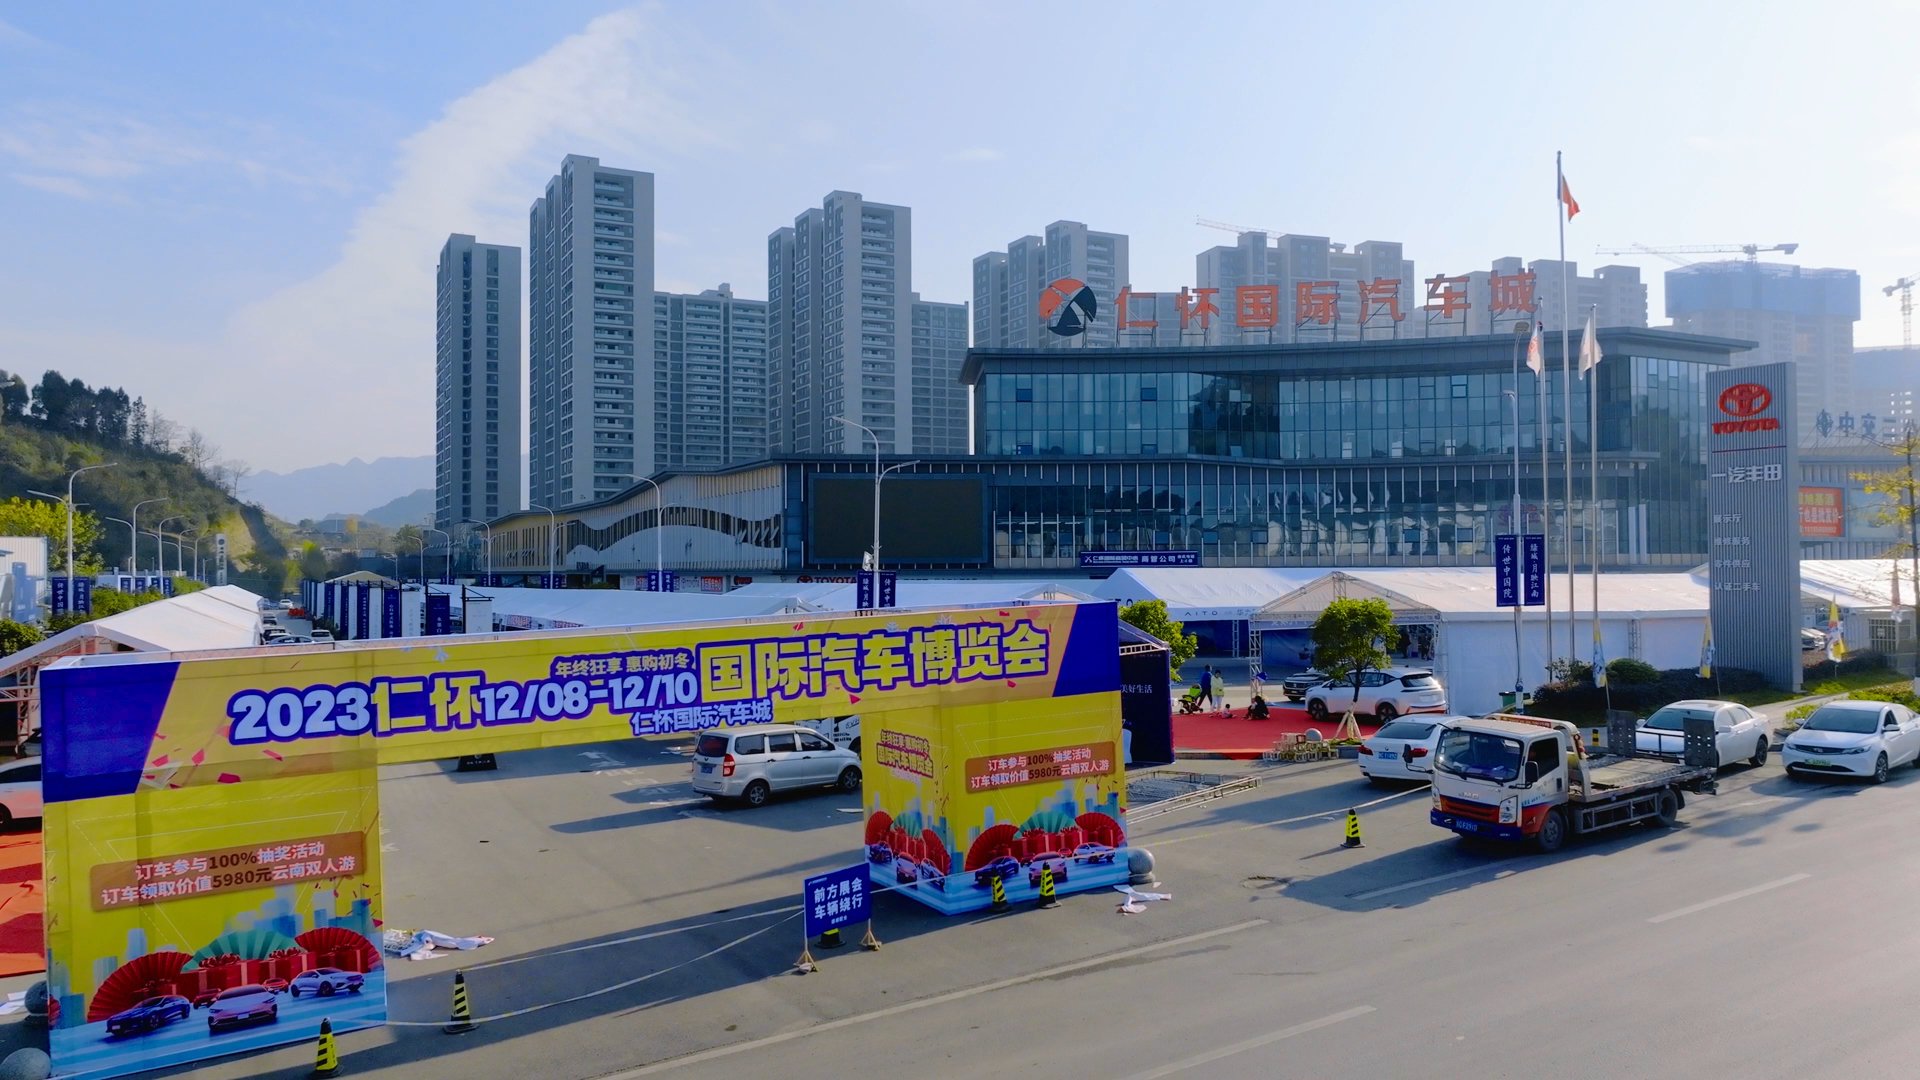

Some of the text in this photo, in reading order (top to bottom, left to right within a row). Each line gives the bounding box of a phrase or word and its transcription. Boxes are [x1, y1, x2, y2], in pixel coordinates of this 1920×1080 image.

[1115, 267, 1539, 330] 仁怀国际汽车城
[1712, 417, 1780, 435] TOYOTA
[1711, 464, 1782, 484] 一汽丰田
[479, 671, 698, 722] 12/08-12/10
[700, 623, 1046, 703] 国际汽车博览会
[556, 652, 691, 678] 年终狂享 惠购初冬
[632, 698, 772, 735] 仁怀国际汽车城
[988, 747, 1092, 772] 订车参与100%抽奖活动
[971, 759, 1110, 789] 订车领取价值5980元云南双人游
[135, 840, 325, 881] 订车参与100%抽奖活动
[101, 855, 356, 906] 订车领取价值5980元云南双人游
[814, 877, 862, 904] 前方展会
[814, 893, 863, 919] 车辆绕行
